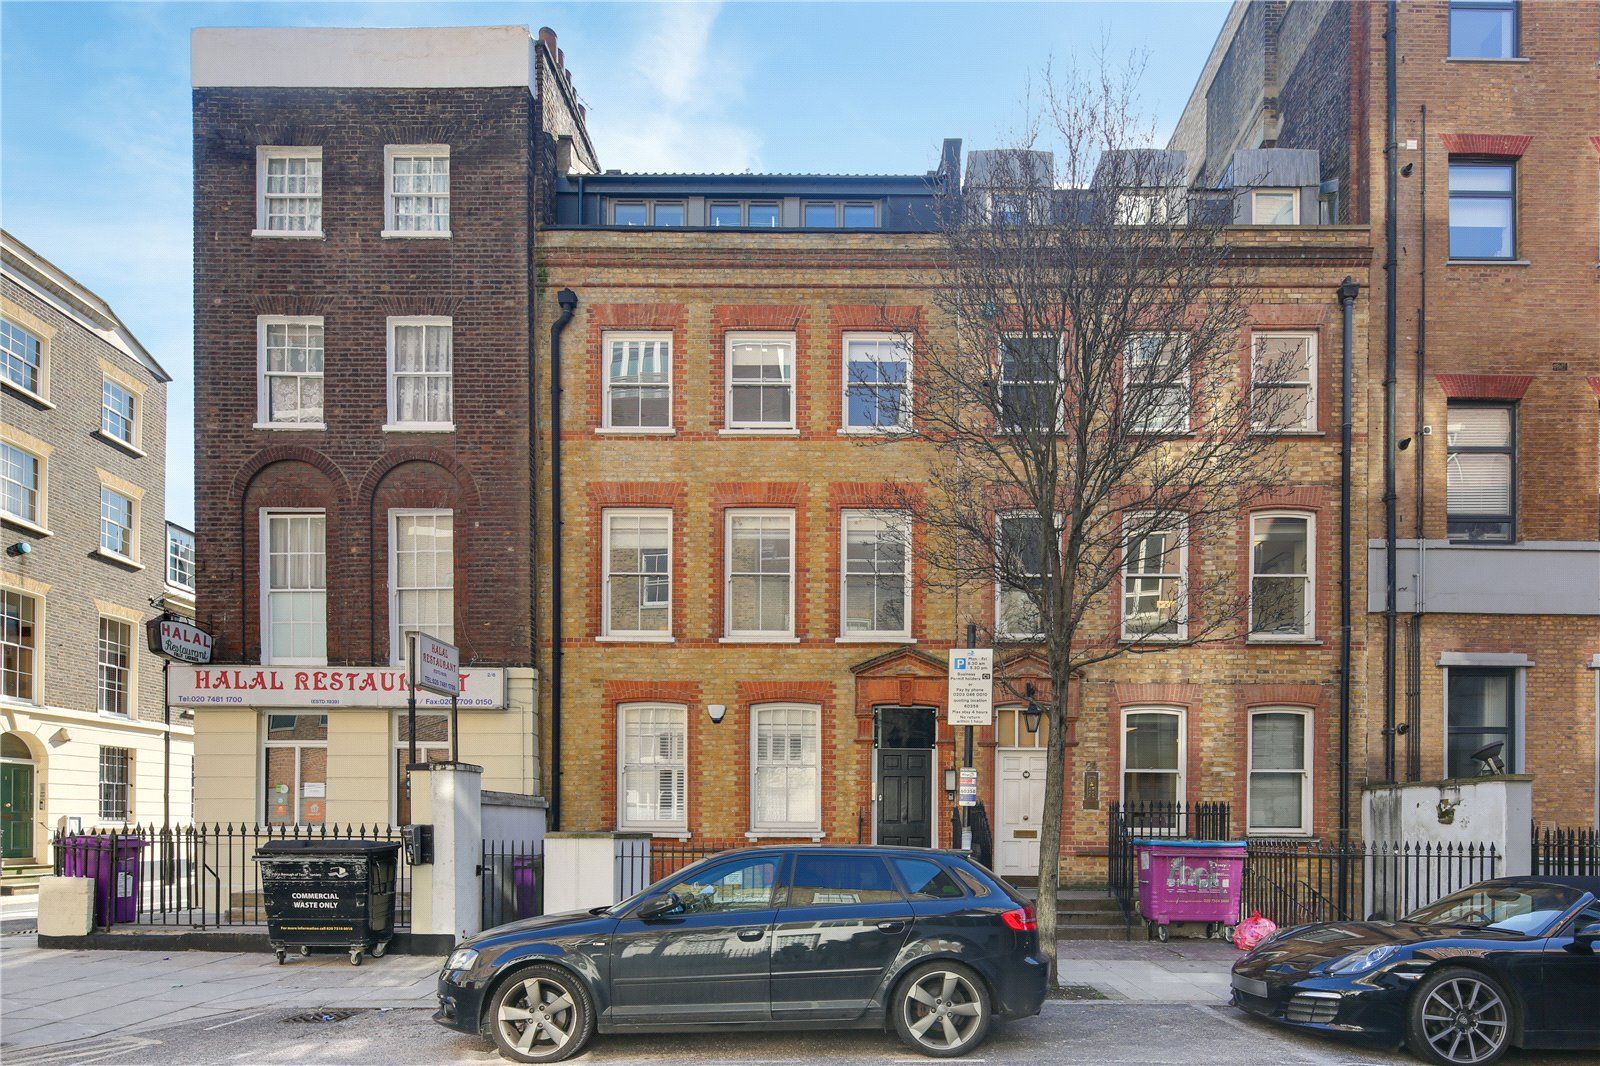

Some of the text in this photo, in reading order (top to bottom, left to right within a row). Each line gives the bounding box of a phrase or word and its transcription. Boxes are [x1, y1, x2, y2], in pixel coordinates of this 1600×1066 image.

[161, 622, 211, 649] HALAL
[164, 638, 209, 660] Restaurant
[431, 643, 449, 659] HALAL
[422, 652, 457, 673] RESTAURANT
[195, 670, 284, 690] HALAL
[294, 671, 471, 692] RESTAUT
[178, 695, 206, 703] Tel:020
[291, 892, 340, 900] COMMERCIAL
[293, 901, 339, 909] WASTE ONLY
